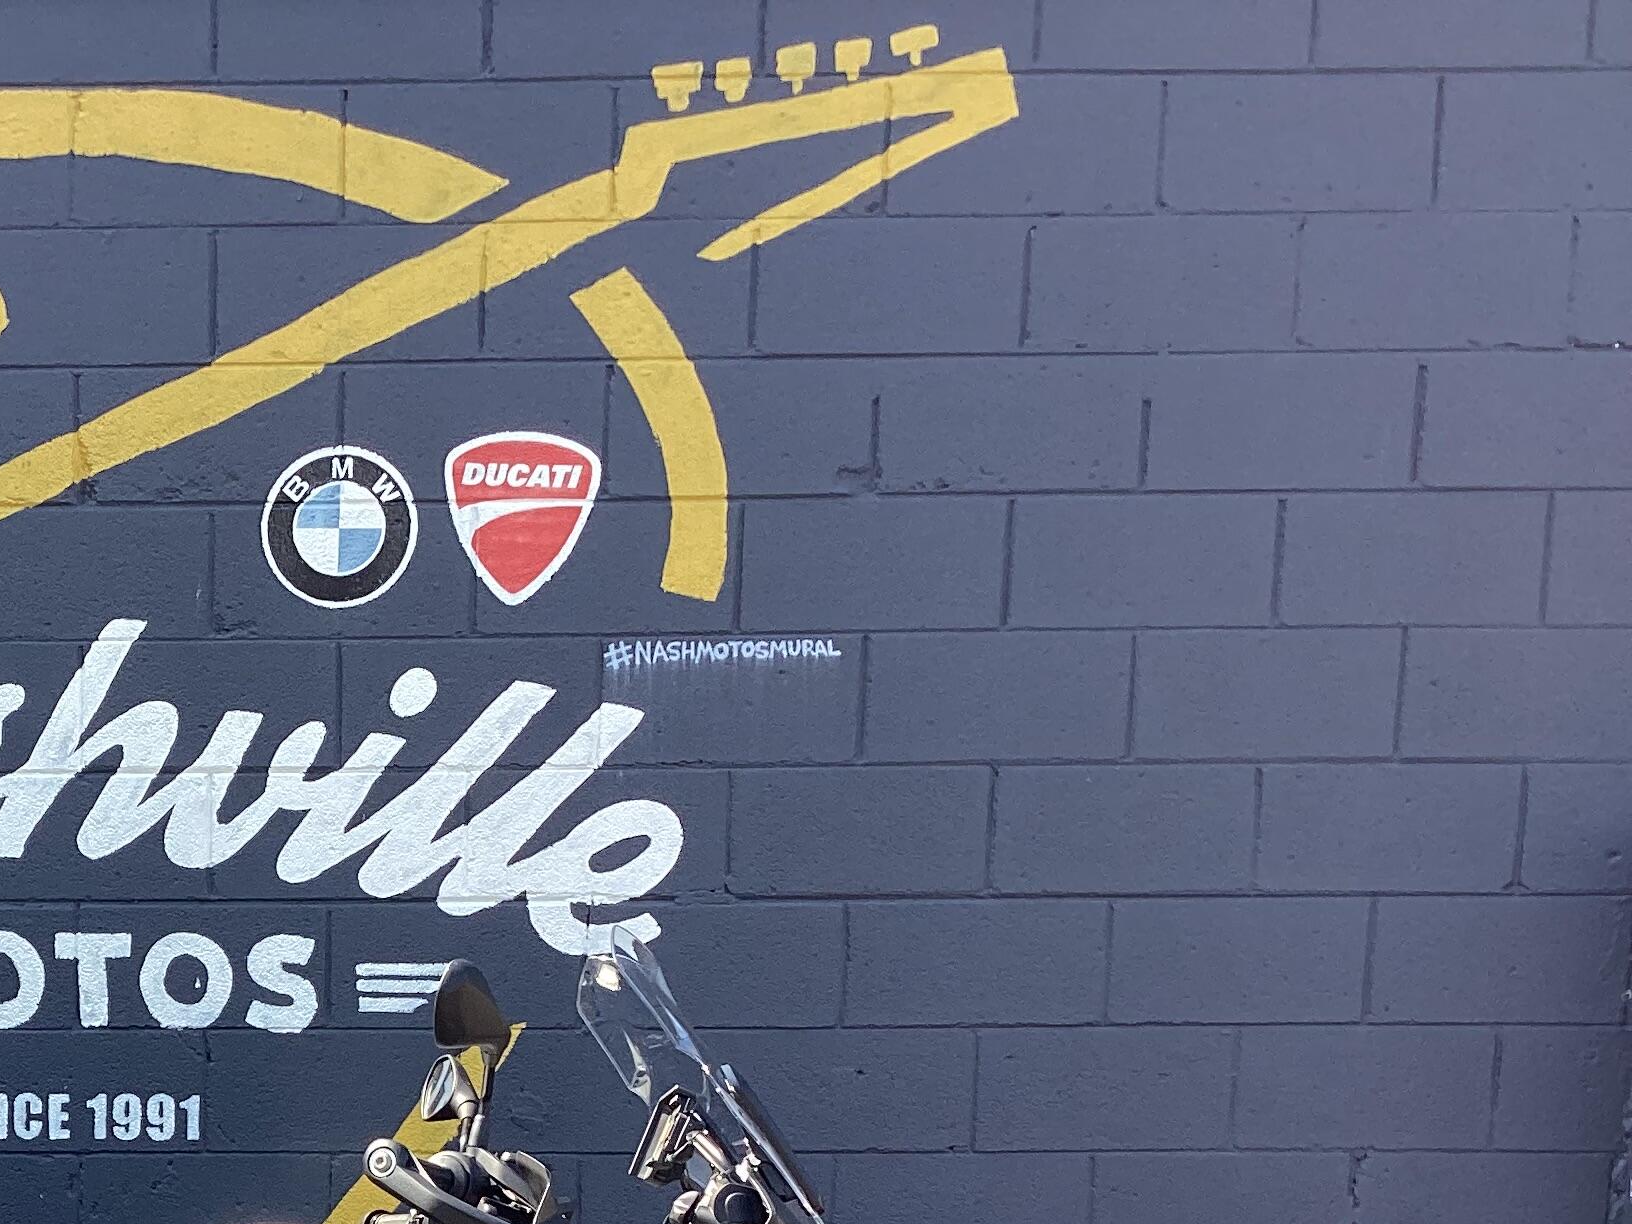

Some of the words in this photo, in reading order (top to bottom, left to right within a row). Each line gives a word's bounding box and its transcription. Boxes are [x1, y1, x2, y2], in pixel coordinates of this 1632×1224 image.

[282, 456, 401, 503] BMW
[461, 462, 584, 489] DUCATI
[604, 639, 842, 670] #NASHMOTOSMURAL
[87, 1092, 202, 1142] 1991
